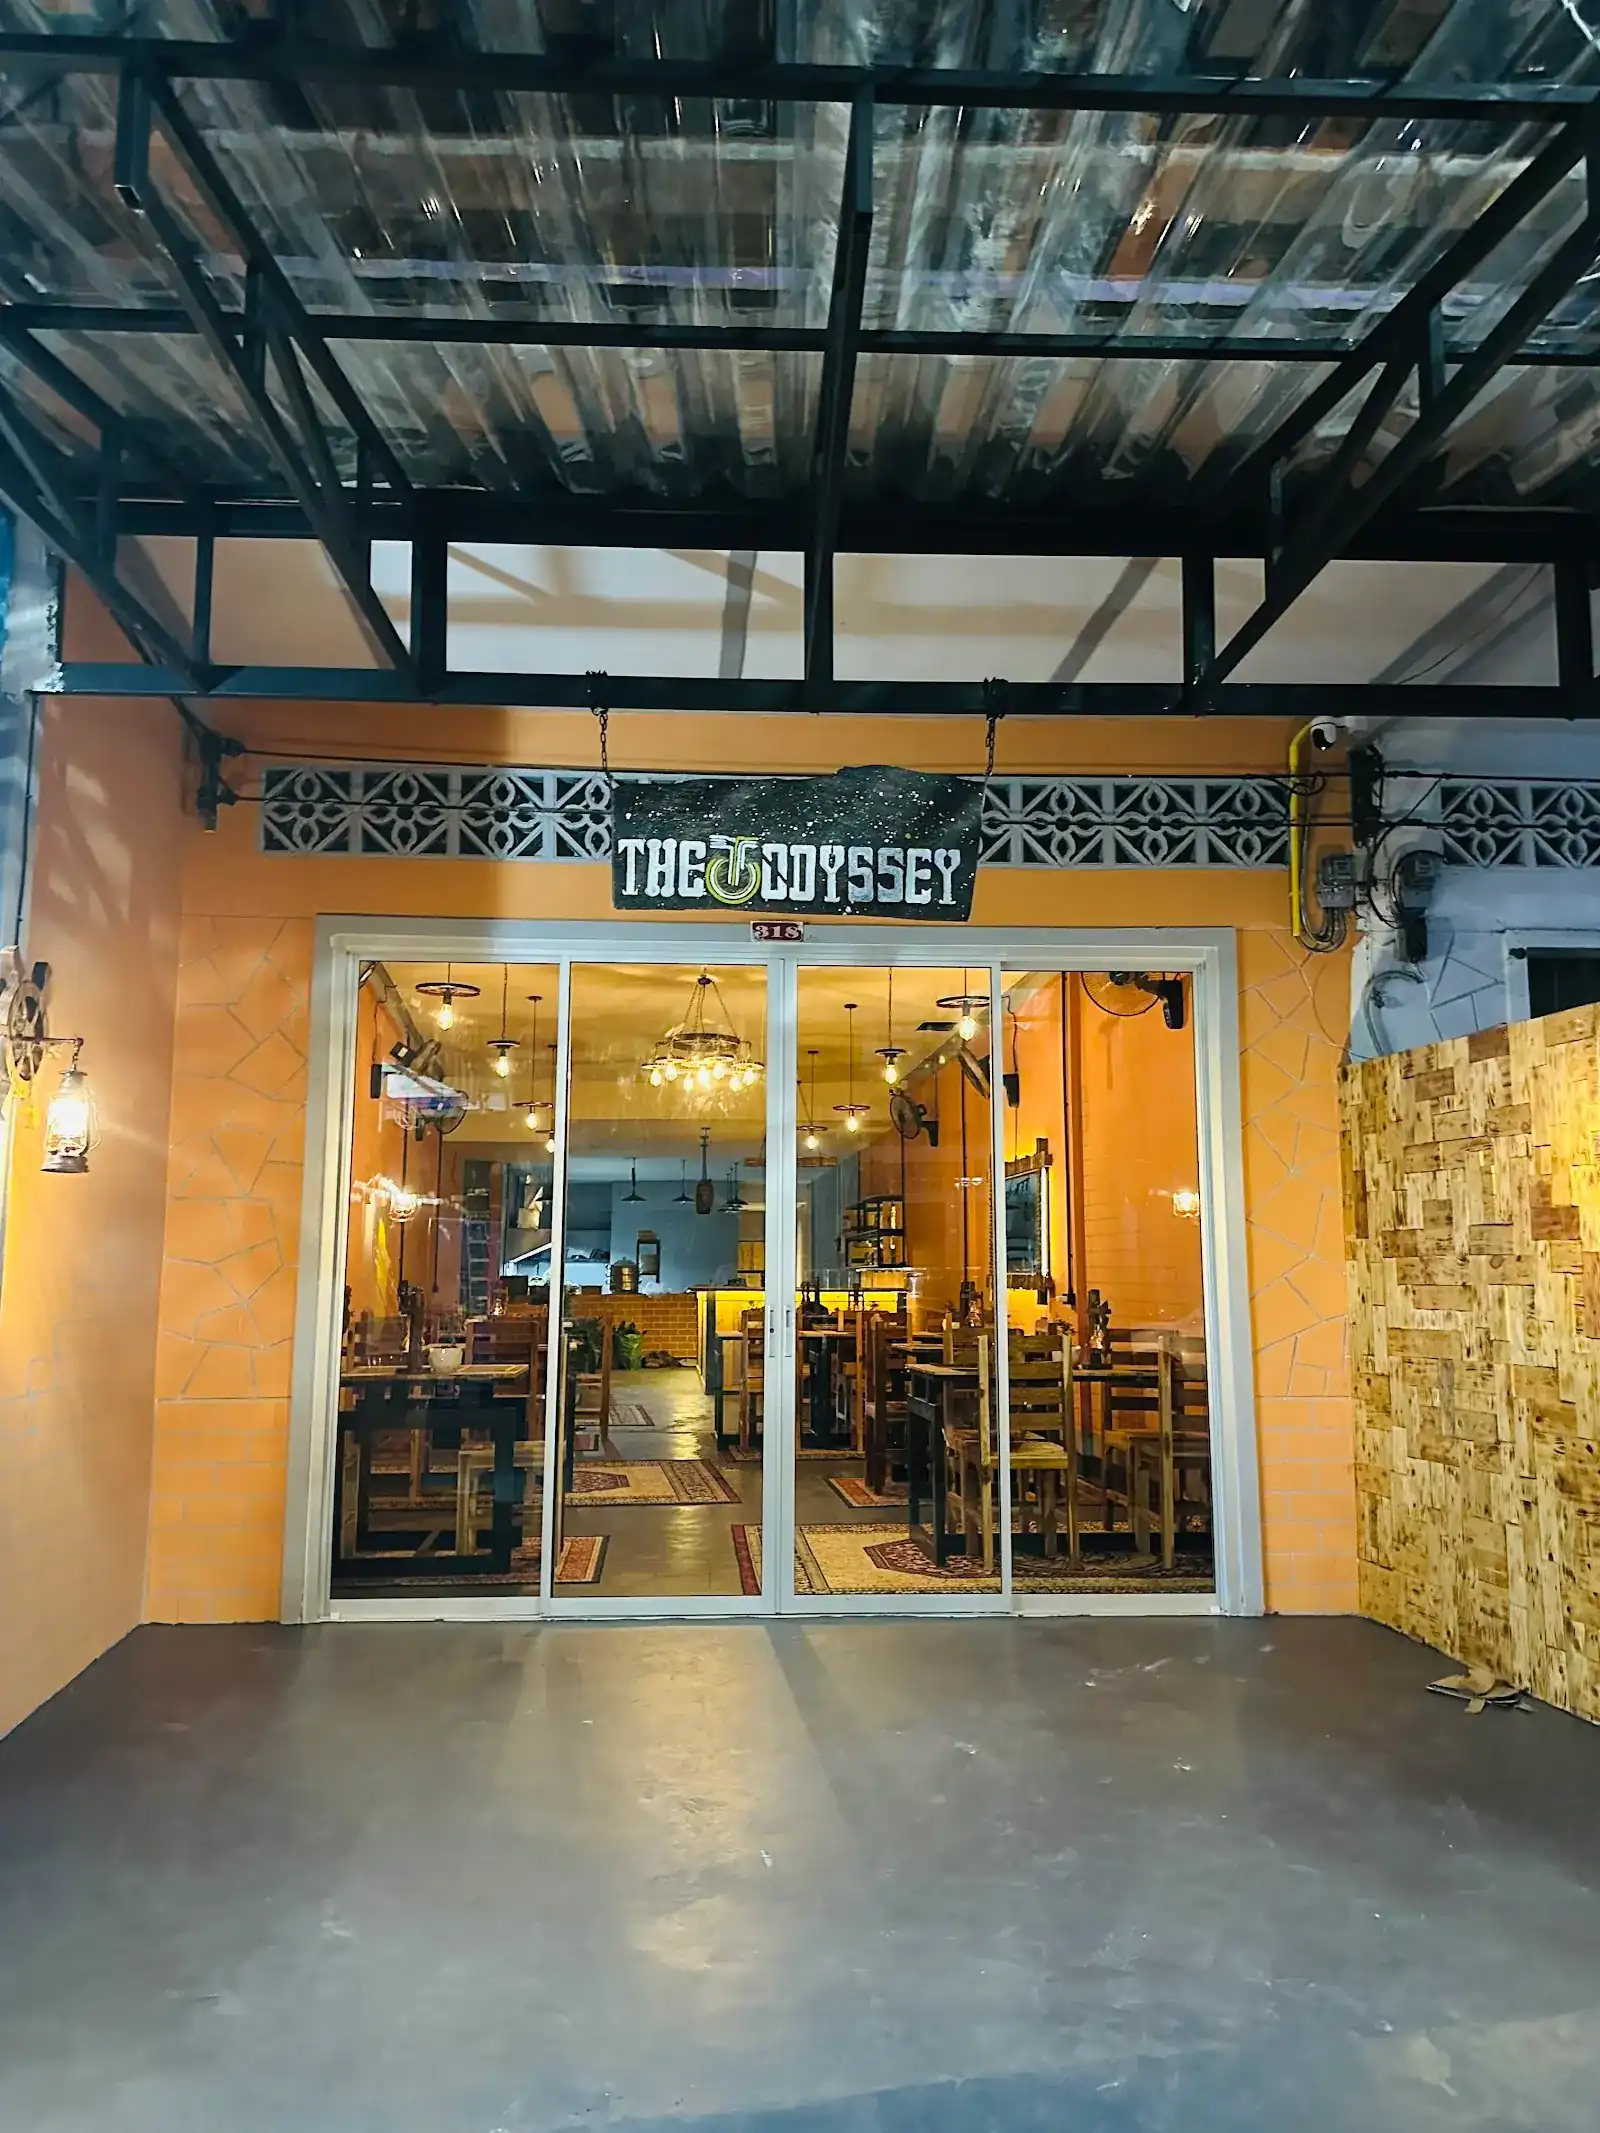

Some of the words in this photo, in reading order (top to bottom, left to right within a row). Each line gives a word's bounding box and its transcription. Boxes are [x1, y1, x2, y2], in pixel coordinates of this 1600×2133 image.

[618, 838, 706, 898] THE
[760, 843, 961, 905] ODYSSEY
[754, 925, 801, 939] 318
